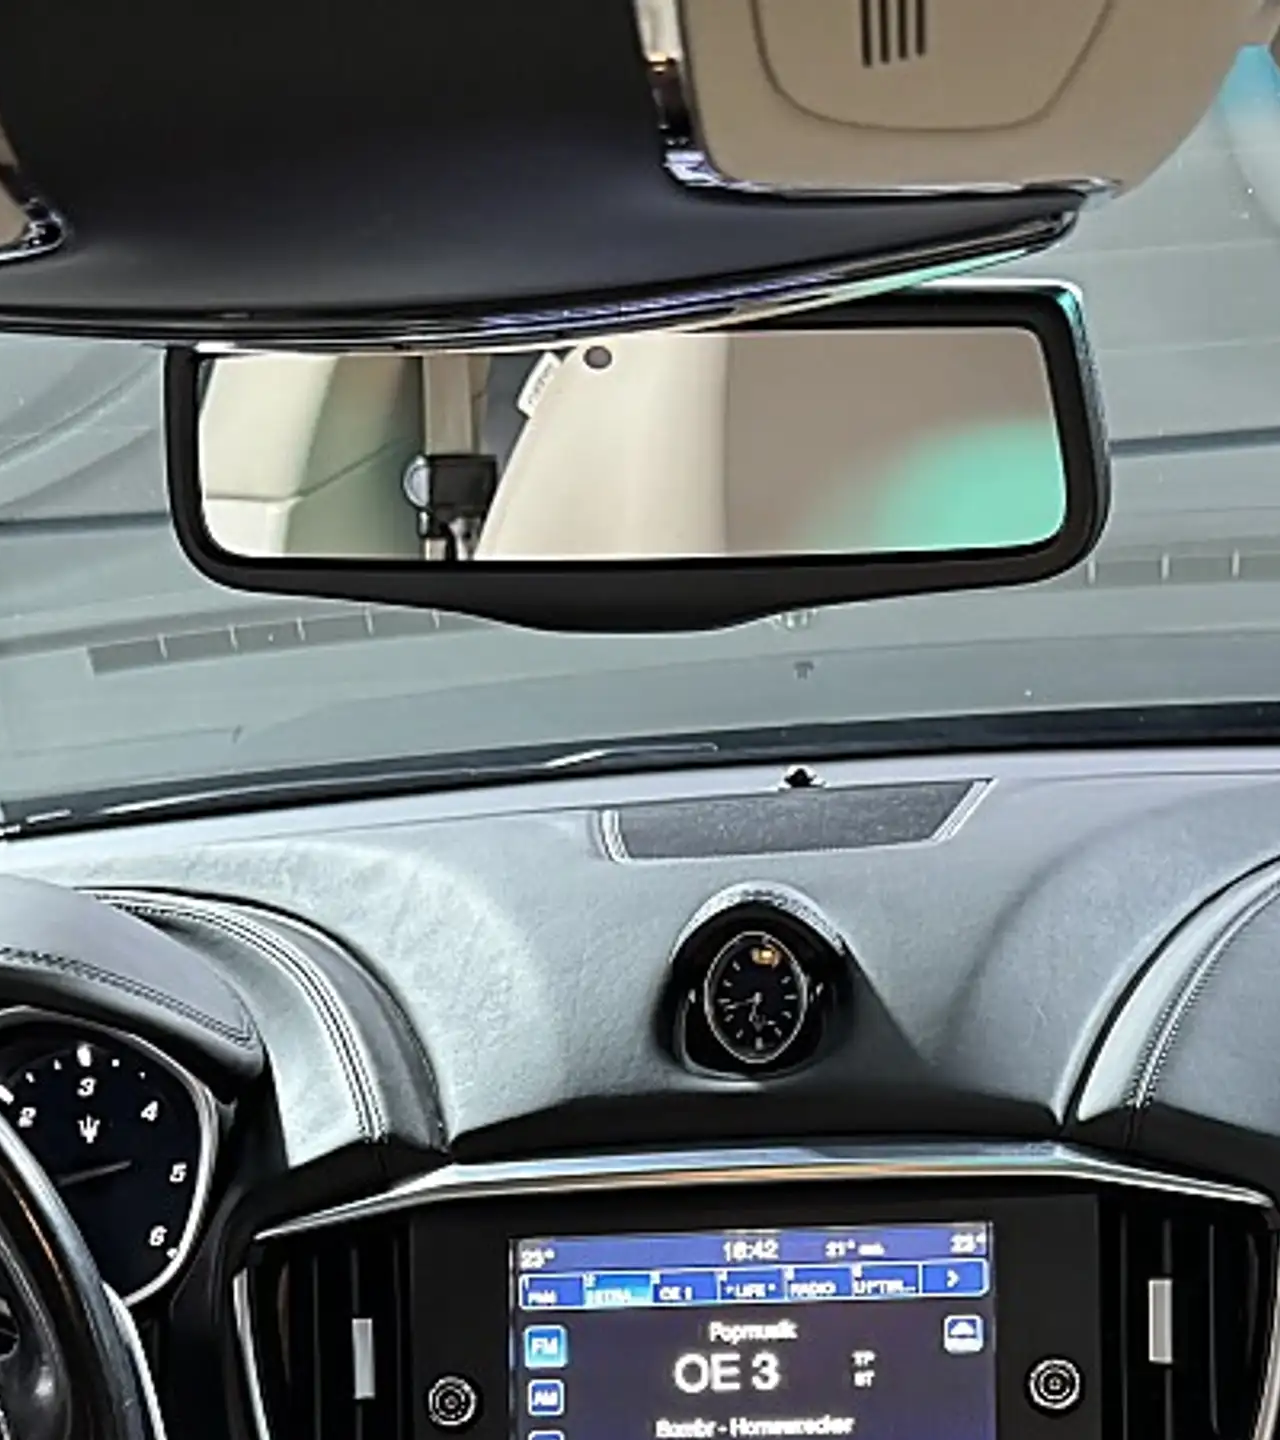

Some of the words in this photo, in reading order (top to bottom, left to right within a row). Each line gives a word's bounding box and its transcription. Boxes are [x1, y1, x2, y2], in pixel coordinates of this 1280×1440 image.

[77, 1077, 97, 1097] 3
[17, 1107, 37, 1128] 2
[140, 1101, 159, 1121] 4
[169, 1162, 187, 1183] 5
[149, 1225, 168, 1246] 6
[531, 1337, 558, 1355] FM
[674, 1353, 741, 1393] OE
[751, 1352, 780, 1391] 3
